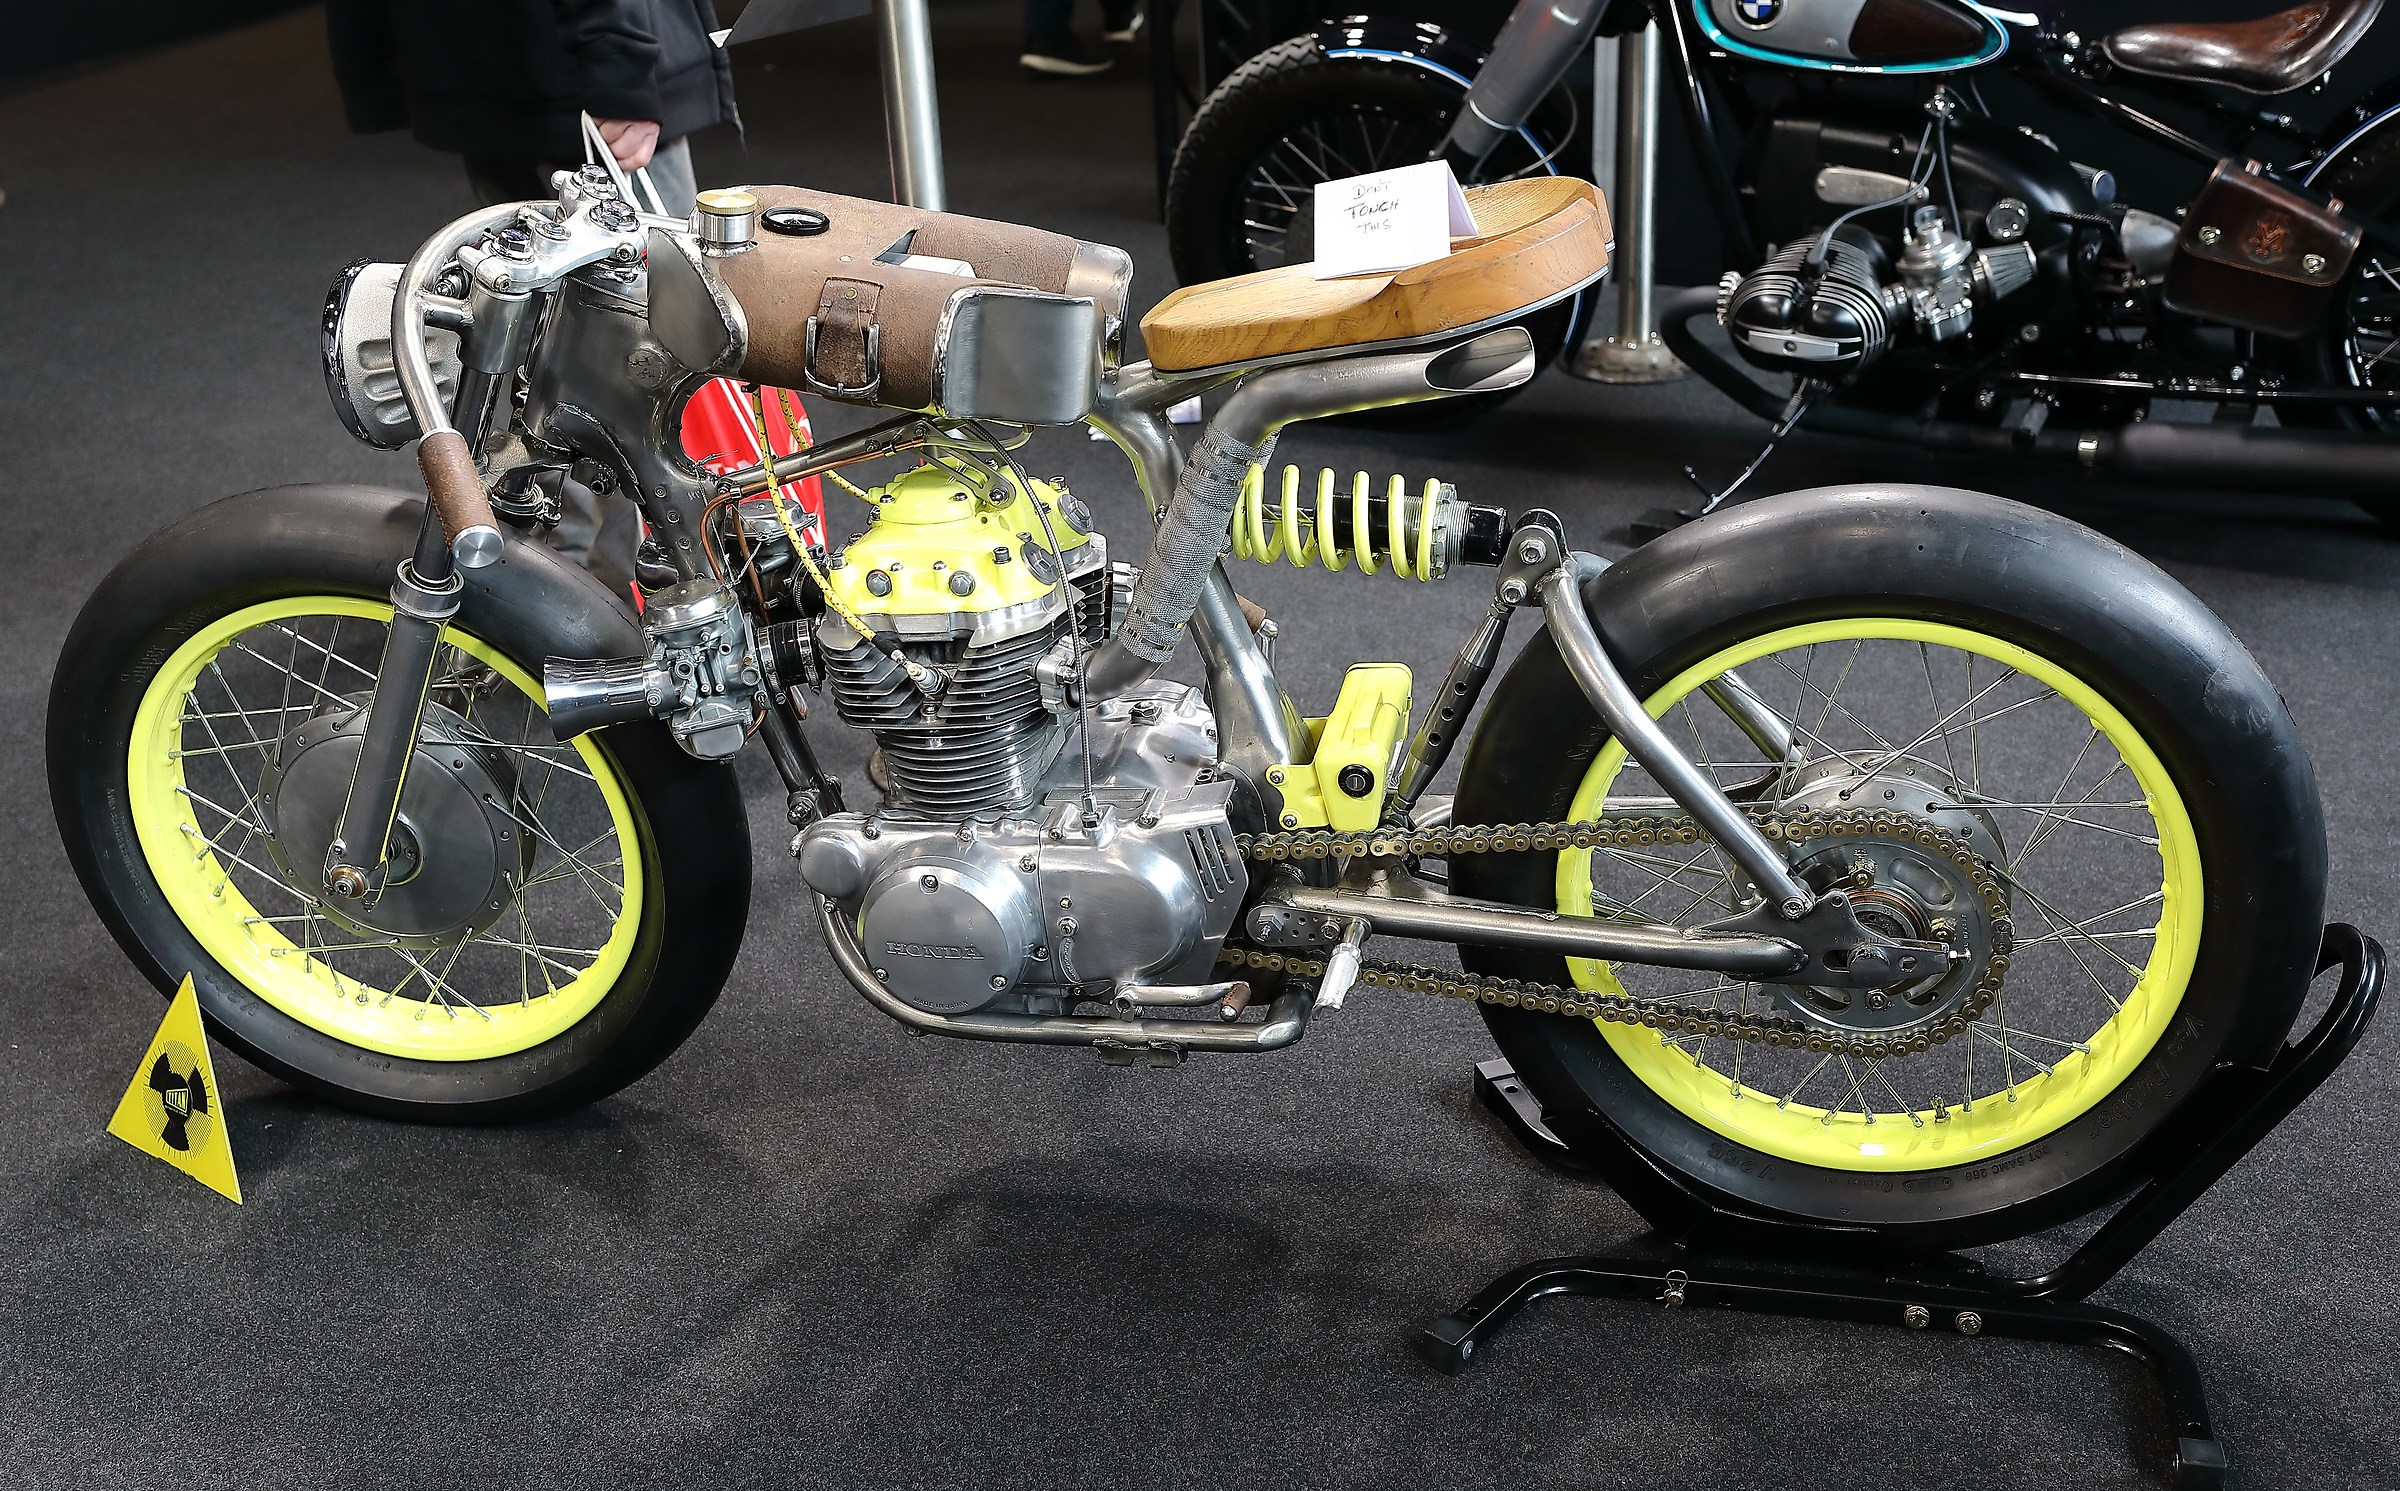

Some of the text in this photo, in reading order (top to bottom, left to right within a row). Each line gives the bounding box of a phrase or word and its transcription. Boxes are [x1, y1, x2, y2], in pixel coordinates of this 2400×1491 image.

[886, 941, 985, 960] HONDA
[913, 997, 934, 1009] MADE
[945, 1001, 969, 1010] JAPAN
